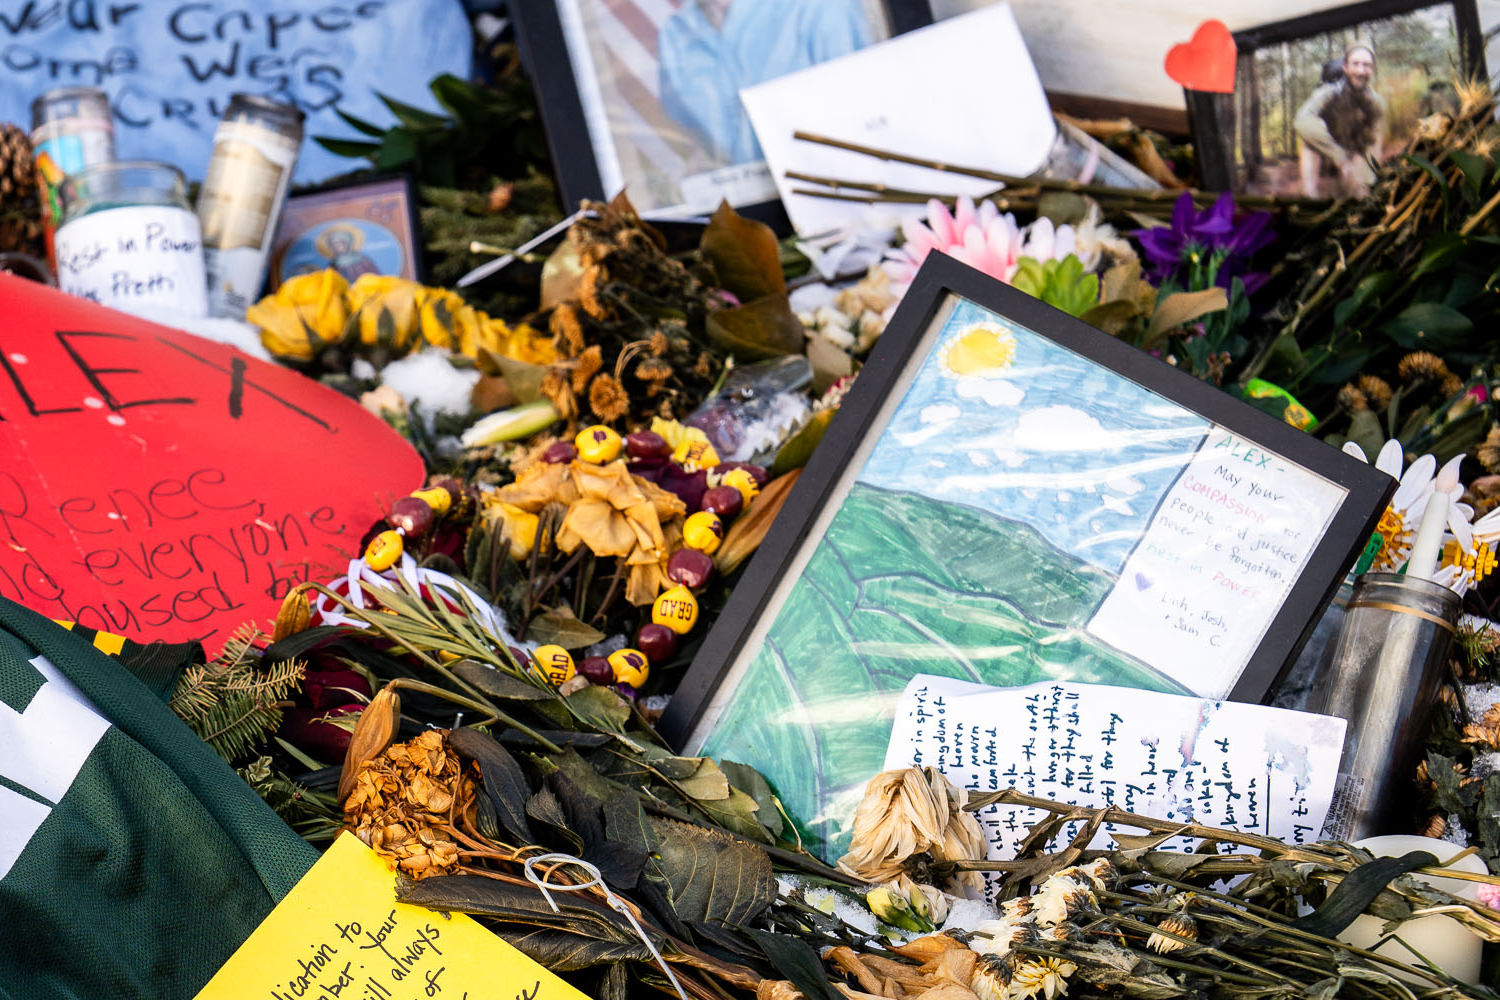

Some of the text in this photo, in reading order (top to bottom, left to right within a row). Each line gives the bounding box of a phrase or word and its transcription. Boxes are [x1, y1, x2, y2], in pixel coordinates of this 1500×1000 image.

[1214, 435, 1273, 470] ALEX
[1213, 465, 1243, 489] May
[658, 598, 694, 622] GRAD
[335, 921, 362, 943] to
[391, 923, 443, 982] always
[424, 966, 446, 998] of
